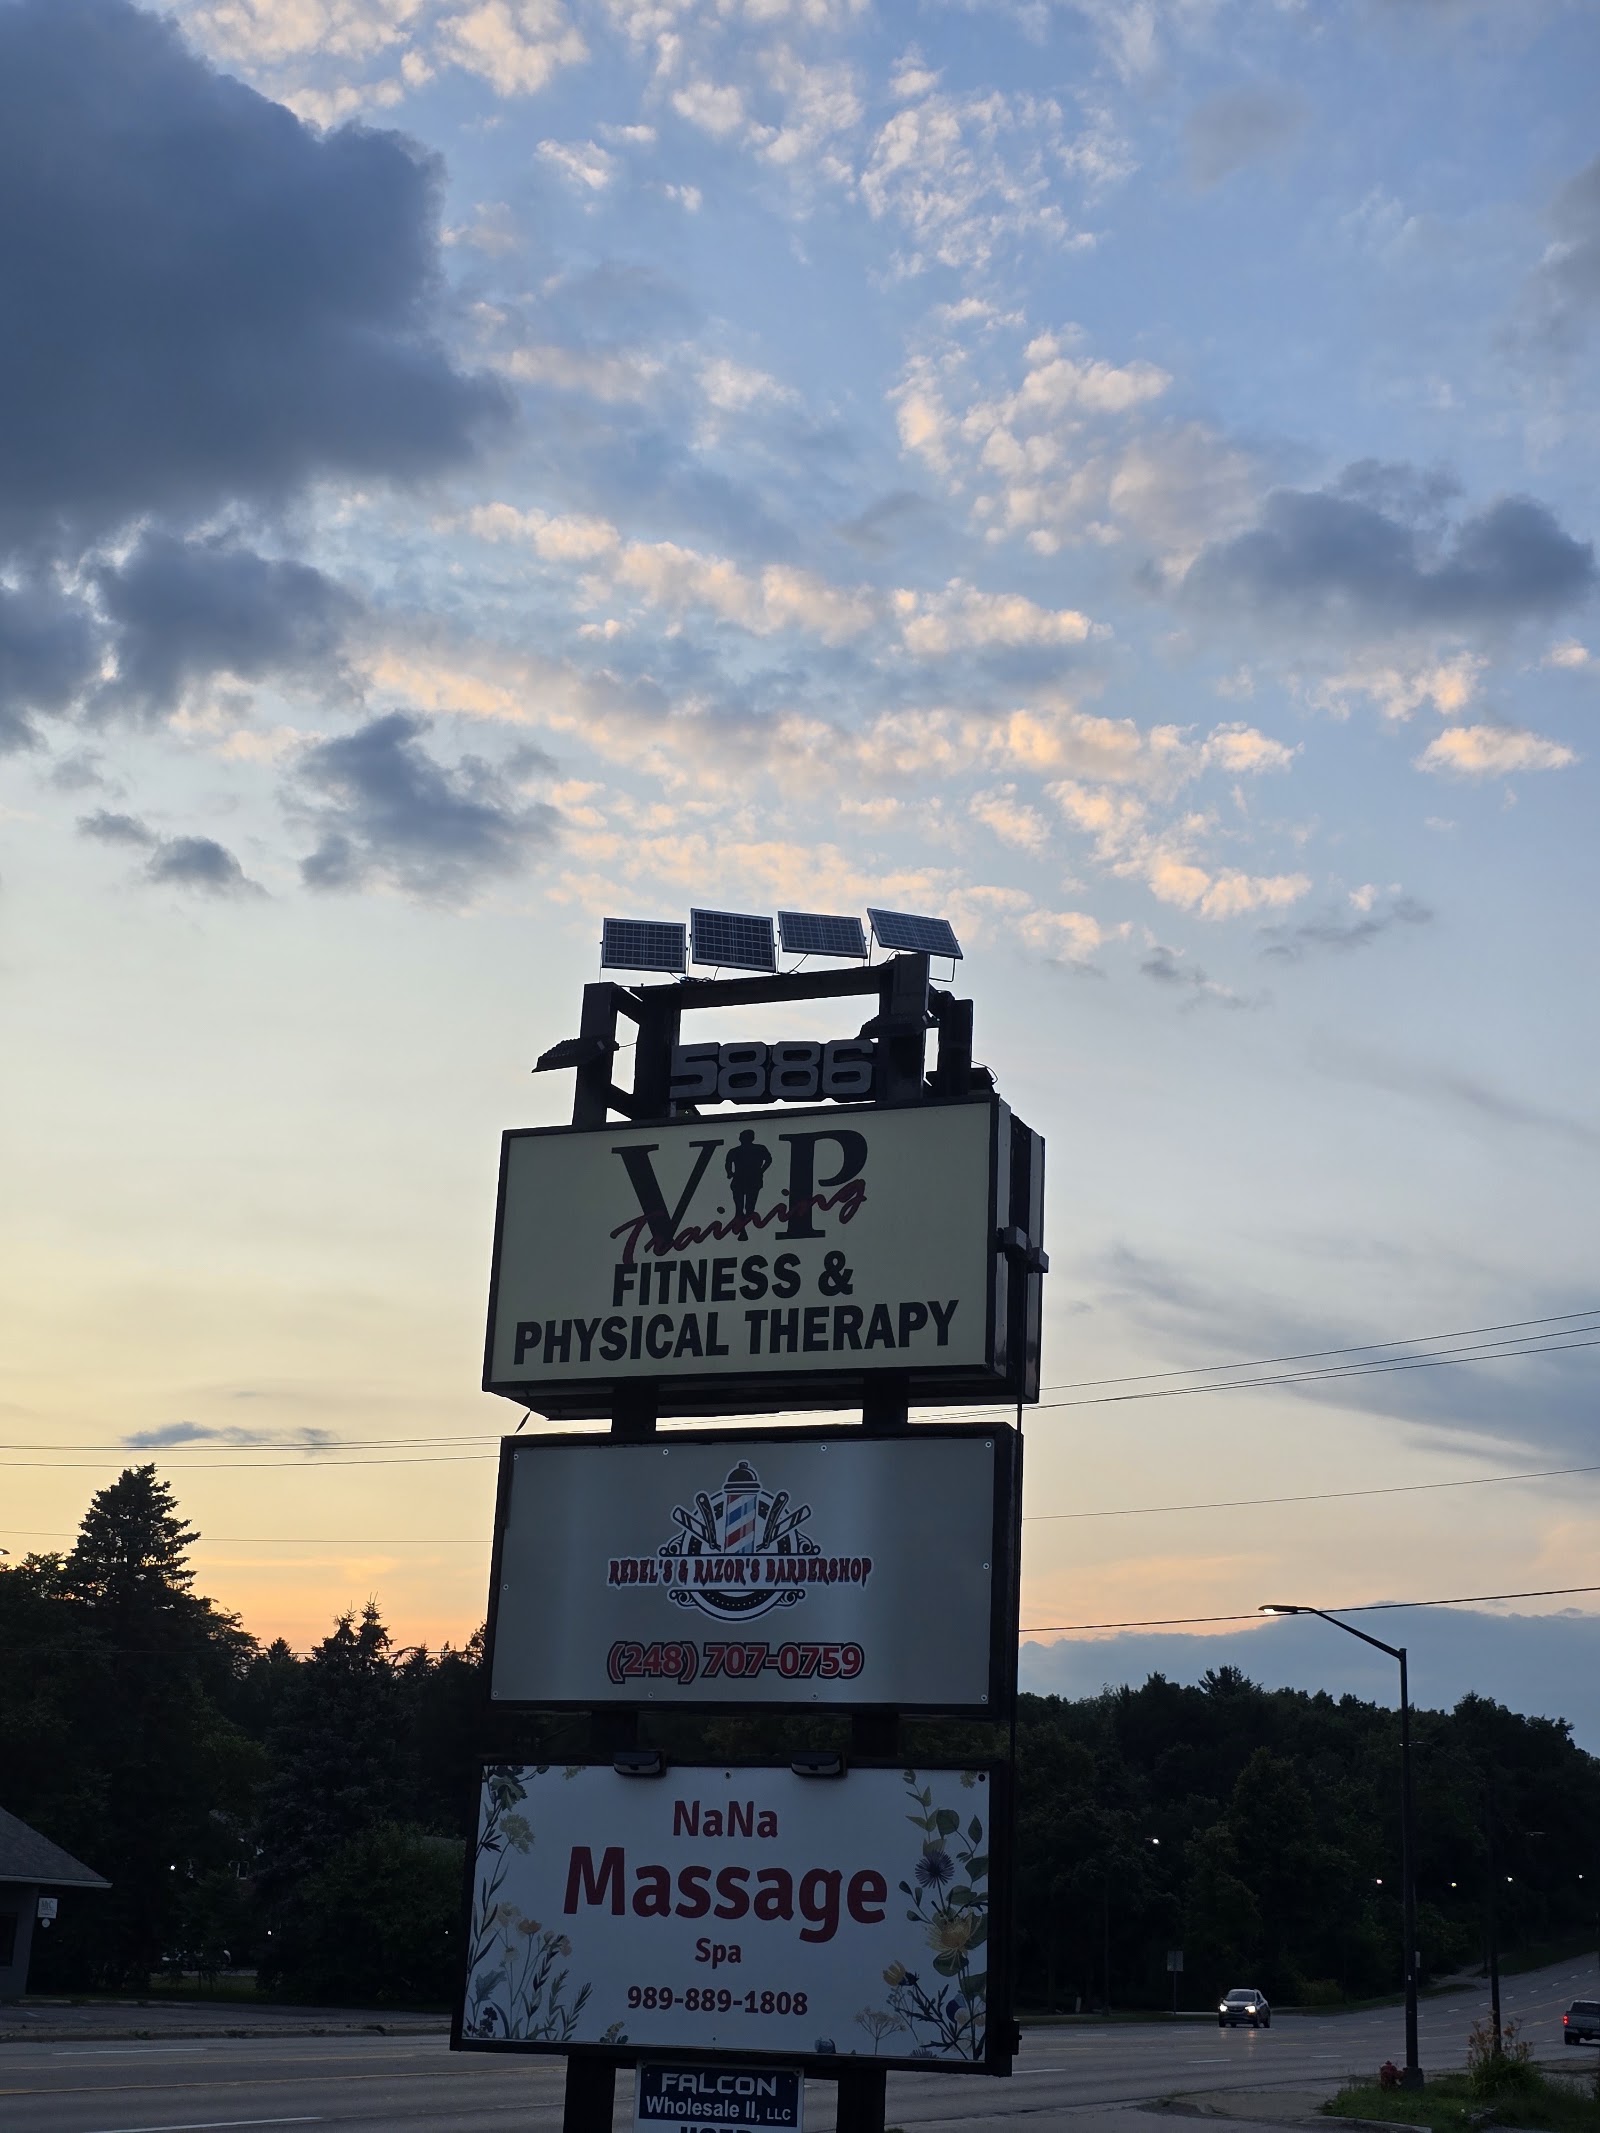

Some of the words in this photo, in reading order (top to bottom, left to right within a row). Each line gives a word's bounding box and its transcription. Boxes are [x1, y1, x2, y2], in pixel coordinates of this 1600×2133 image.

[670, 1040, 874, 1103] 5886
[610, 1179, 867, 1263] Training
[612, 1254, 801, 1307] FITNESS
[818, 1251, 853, 1296] &
[513, 1312, 729, 1365] PHYSICAL
[745, 1300, 959, 1354] THERAPY
[608, 1559, 672, 1586] REBEL'S
[678, 1559, 688, 1584] &
[693, 1558, 760, 1587] RAZOR'S
[765, 1557, 872, 1587] BARBERSHOP
[607, 1641, 699, 1685] (248)
[700, 1641, 864, 1680] 707-0759
[673, 1800, 778, 1838] NaNa
[563, 1846, 888, 1943] Massage
[694, 1937, 742, 1969] Spa
[627, 1985, 808, 2016] 989-889-1808
[661, 2072, 777, 2097] FALCON
[646, 2095, 740, 2118] Wholesale
[766, 2107, 791, 2120] LLC
